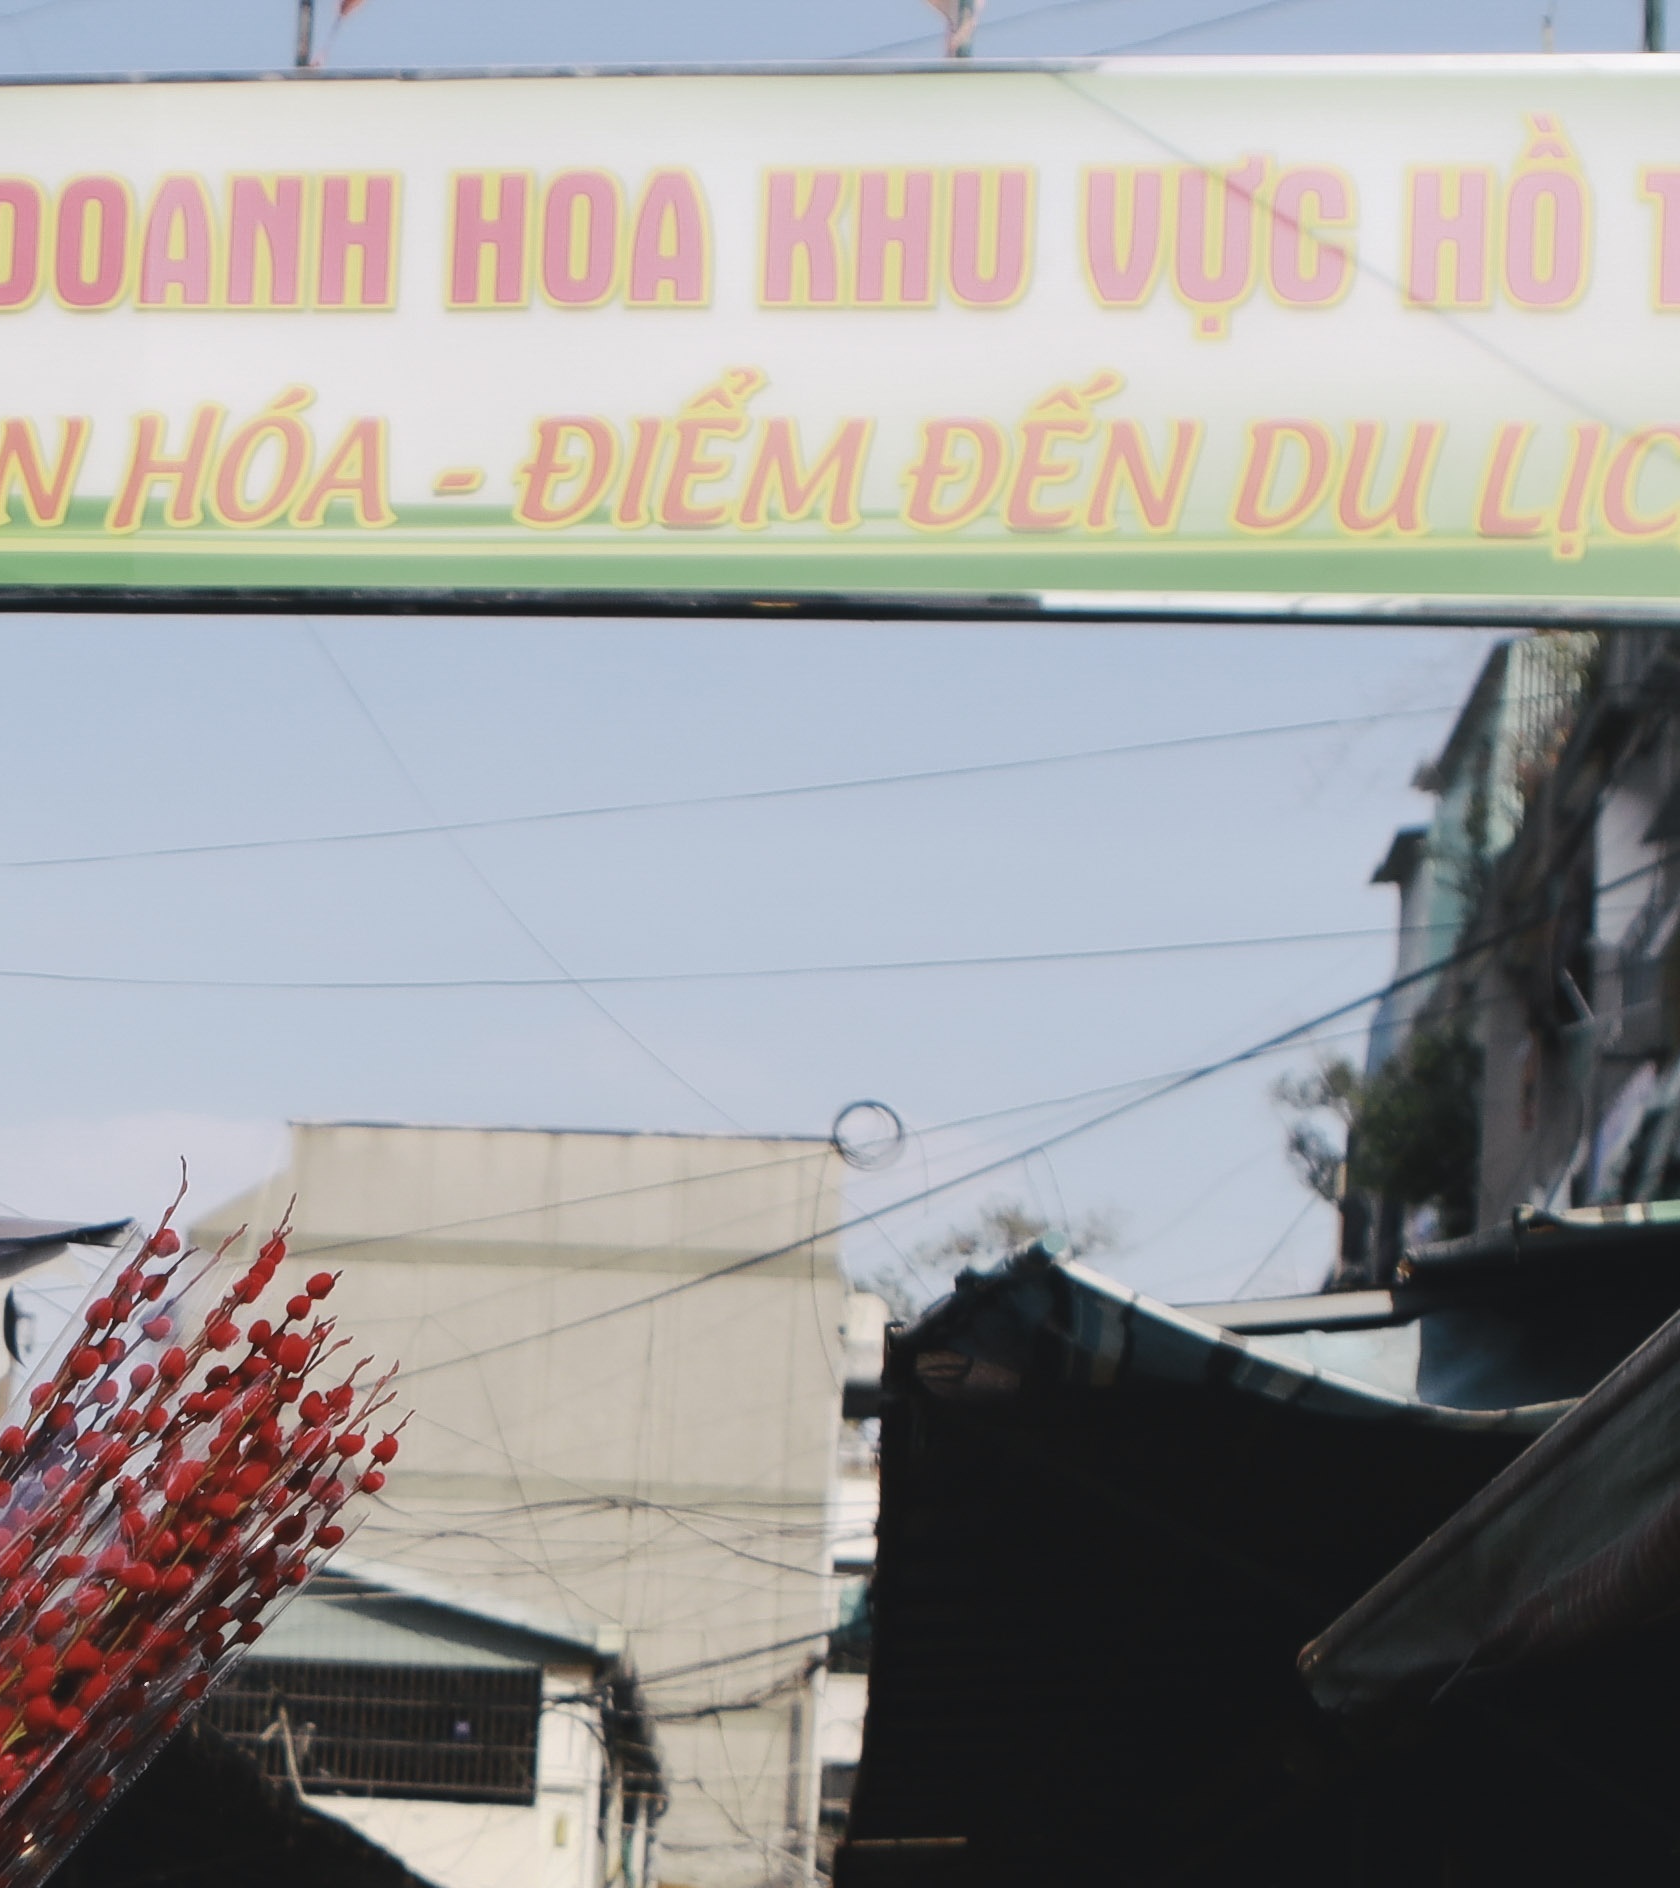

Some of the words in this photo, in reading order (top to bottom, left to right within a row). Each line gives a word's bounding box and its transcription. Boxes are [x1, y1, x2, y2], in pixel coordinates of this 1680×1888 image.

[443, 165, 714, 312] HOA
[753, 161, 1032, 312] KHU
[1078, 151, 1357, 341] VỰC
[1401, 112, 1595, 312] HỒ
[105, 382, 399, 538] HÓA
[512, 367, 875, 533] ĐIỂM
[898, 371, 1207, 538] ĐẾN
[1226, 415, 1444, 541] DU
